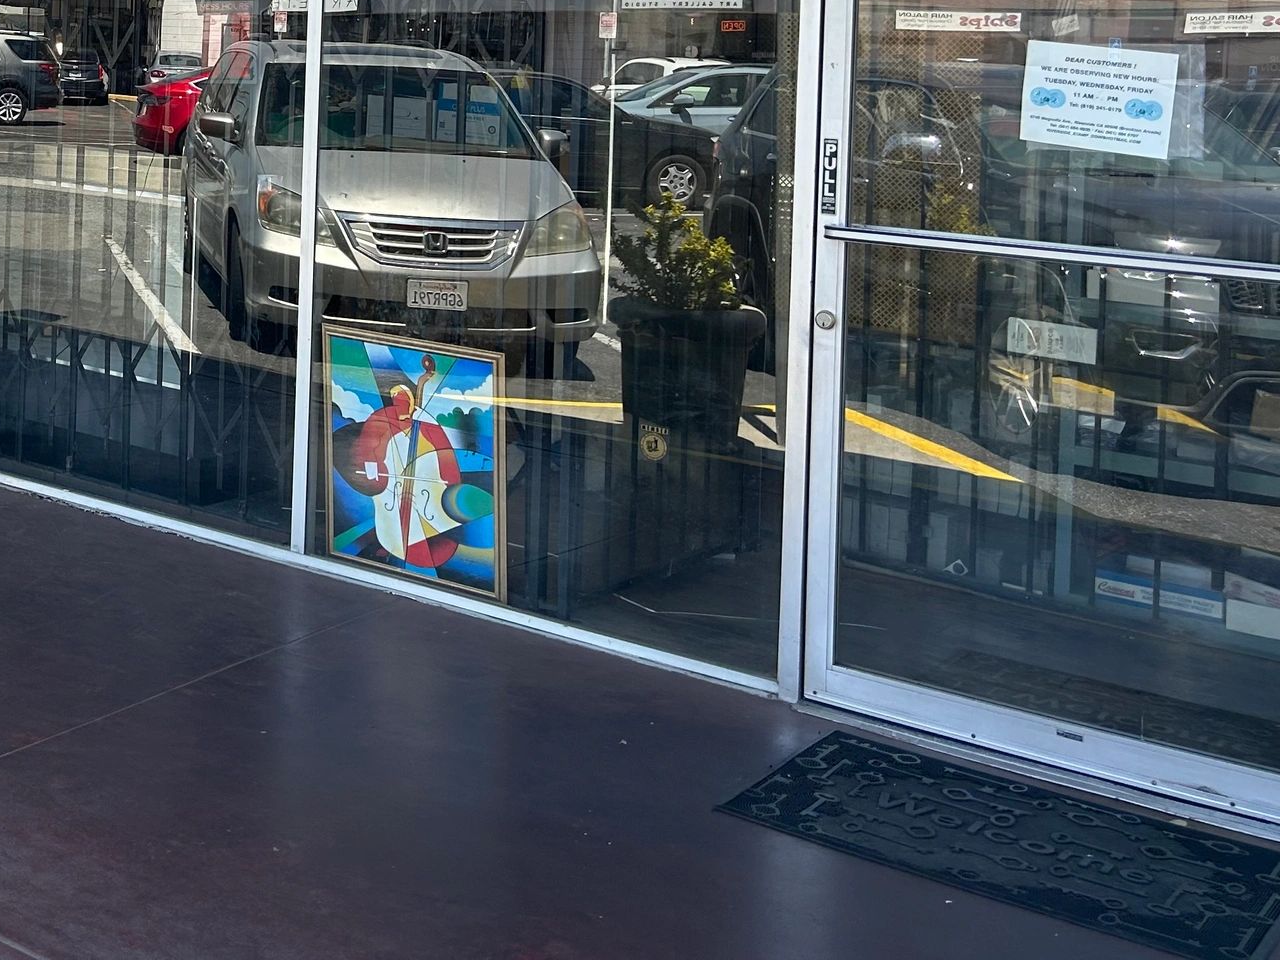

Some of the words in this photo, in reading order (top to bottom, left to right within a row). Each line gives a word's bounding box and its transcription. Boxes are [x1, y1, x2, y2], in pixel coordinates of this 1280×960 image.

[1065, 56, 1085, 64] DEAR
[1086, 58, 1131, 68] CUSTOMERS
[1070, 68, 1111, 78] OBSERVING
[1127, 86, 1154, 94] FRIDAY
[824, 143, 837, 197] PULL
[877, 789, 1157, 885] Welcome
